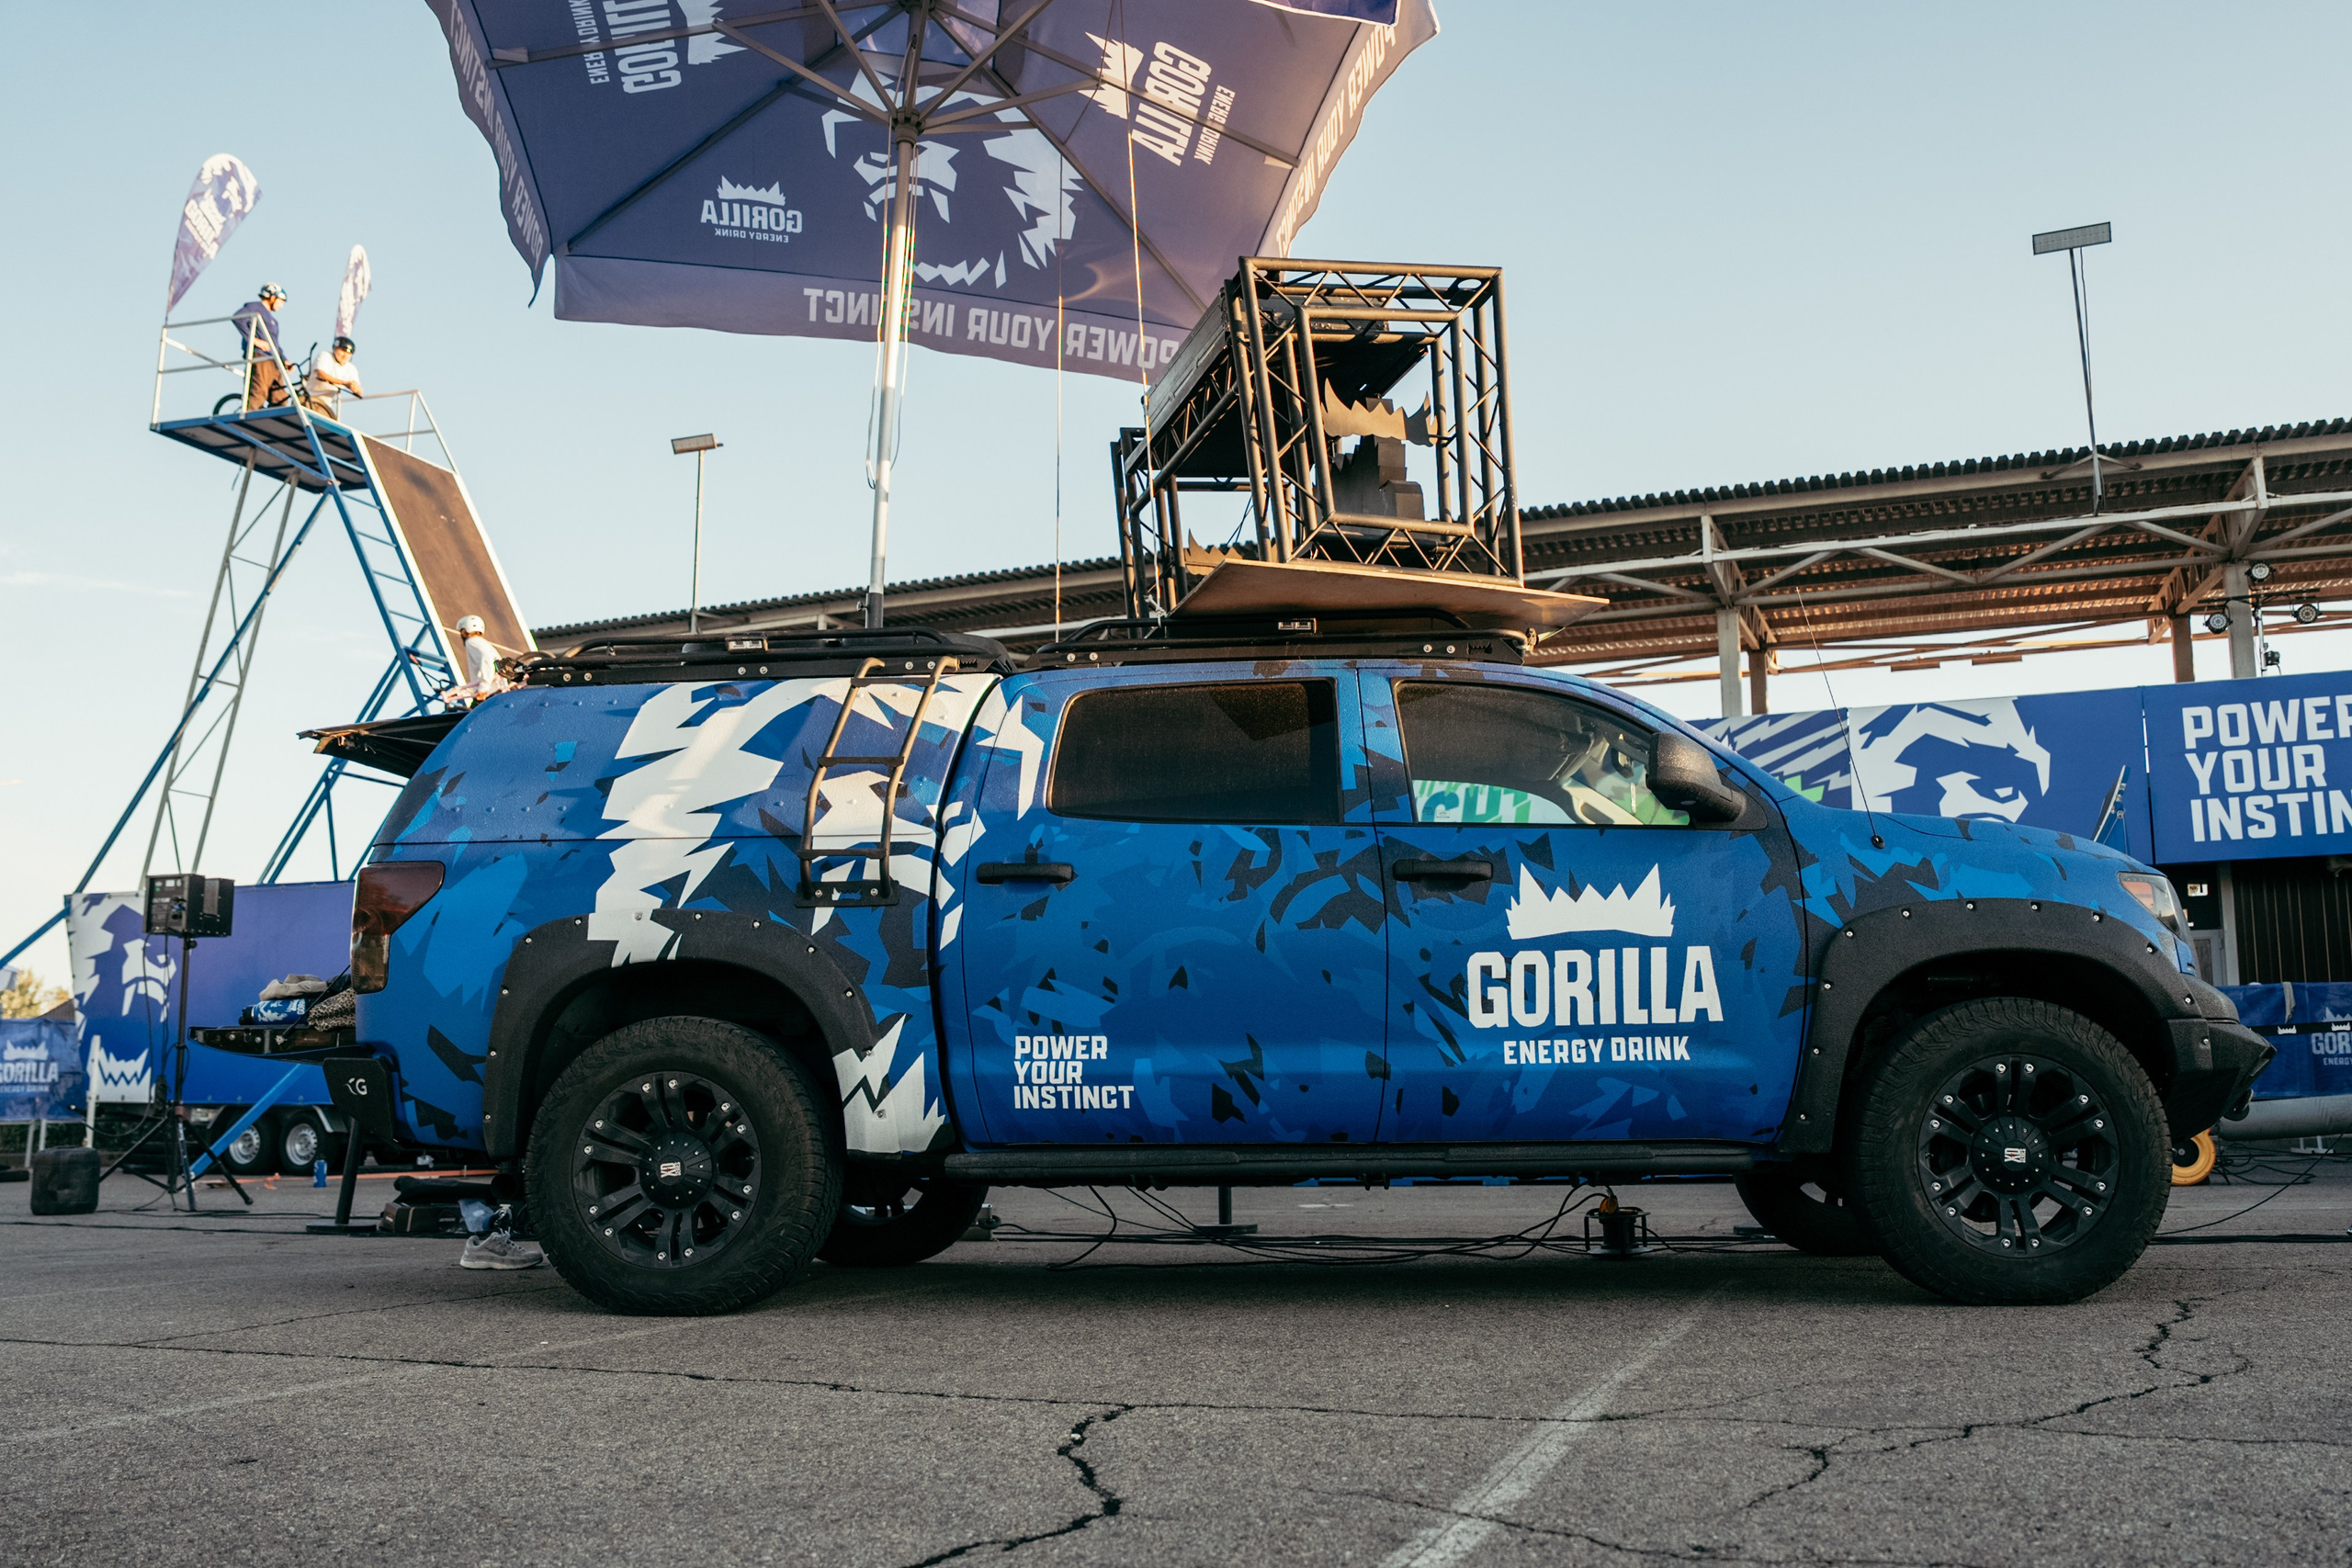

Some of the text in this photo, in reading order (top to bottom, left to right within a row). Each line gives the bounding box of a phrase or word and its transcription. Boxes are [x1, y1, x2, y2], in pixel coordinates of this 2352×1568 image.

[2184, 744, 2327, 795] YOUR
[1466, 945, 1724, 1029] GORILLA
[1014, 1035, 1108, 1060] POWER
[1503, 1035, 1690, 1065] ENERGY DRINK
[2311, 1032, 2352, 1055] GOR
[1013, 1061, 1083, 1084] YOUR
[1013, 1085, 1135, 1110] INSTINCT
